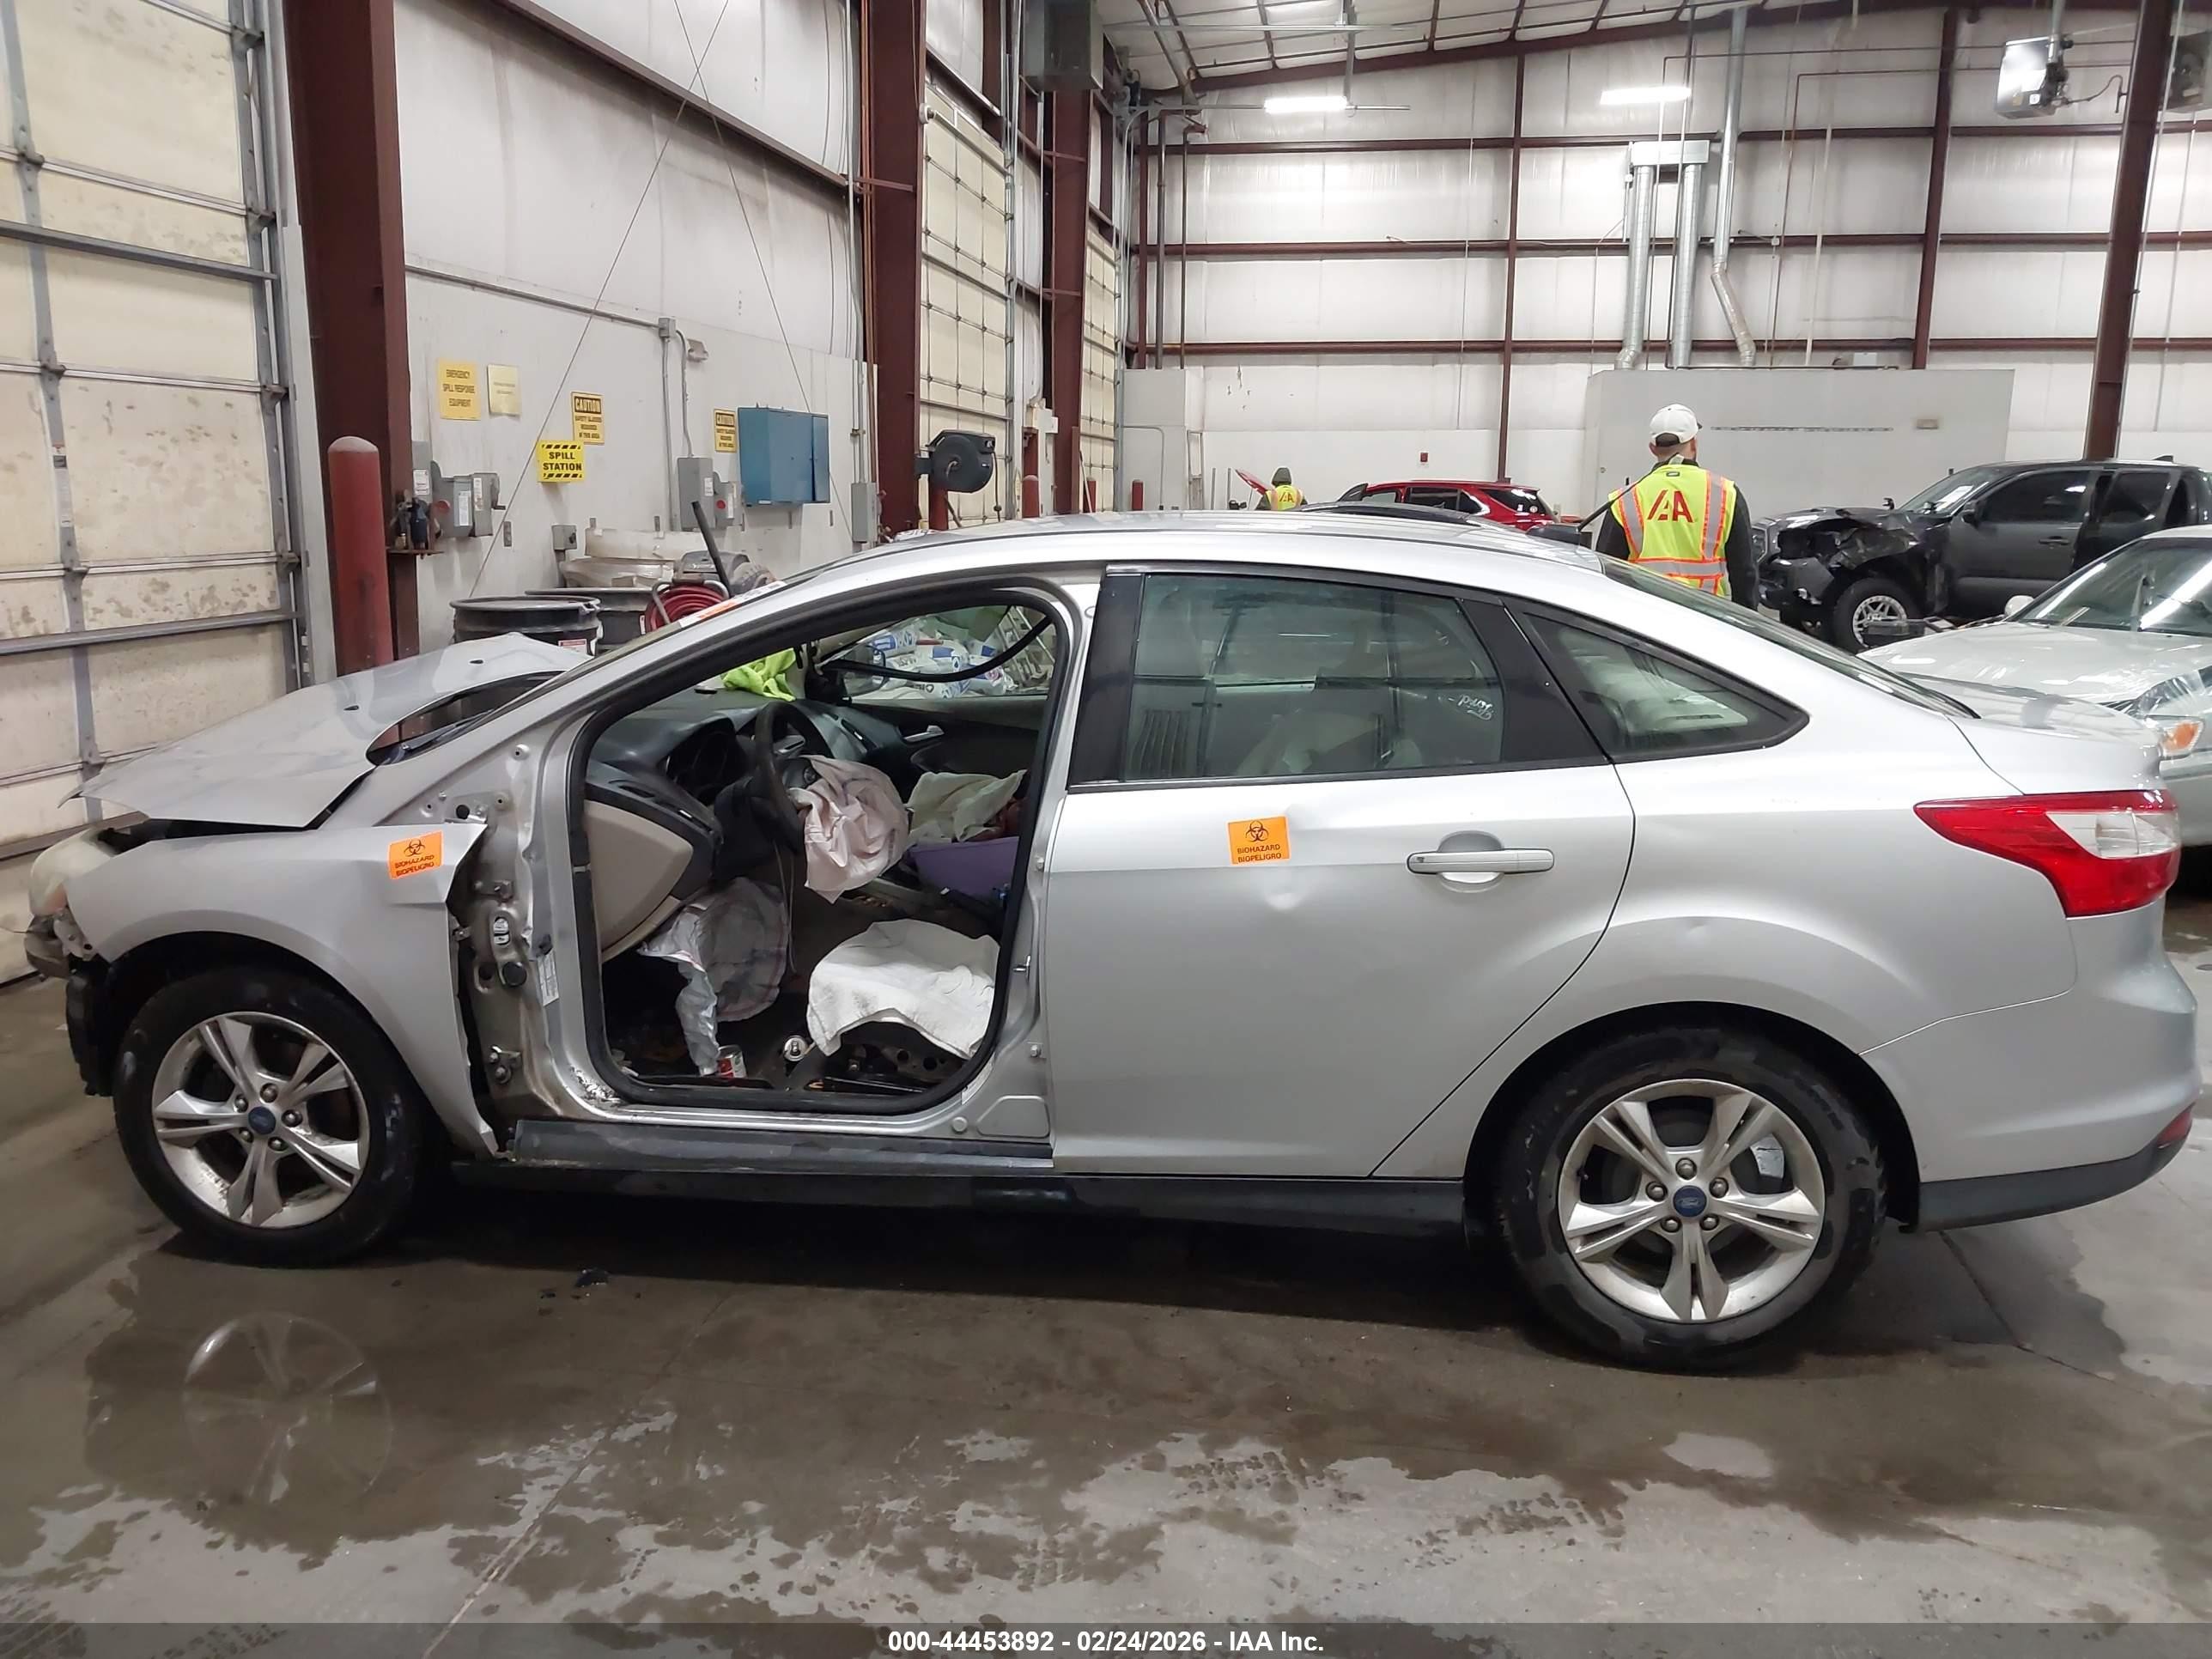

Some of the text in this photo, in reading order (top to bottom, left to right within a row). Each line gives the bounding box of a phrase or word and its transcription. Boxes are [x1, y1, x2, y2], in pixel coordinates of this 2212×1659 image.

[575, 398, 601, 413] CAUTION
[549, 452, 575, 460] SPILL
[1237, 844, 1280, 854] BIOHAZARD
[395, 854, 434, 868] BIOHAZARD
[1237, 852, 1282, 863] BIOPELIGRO
